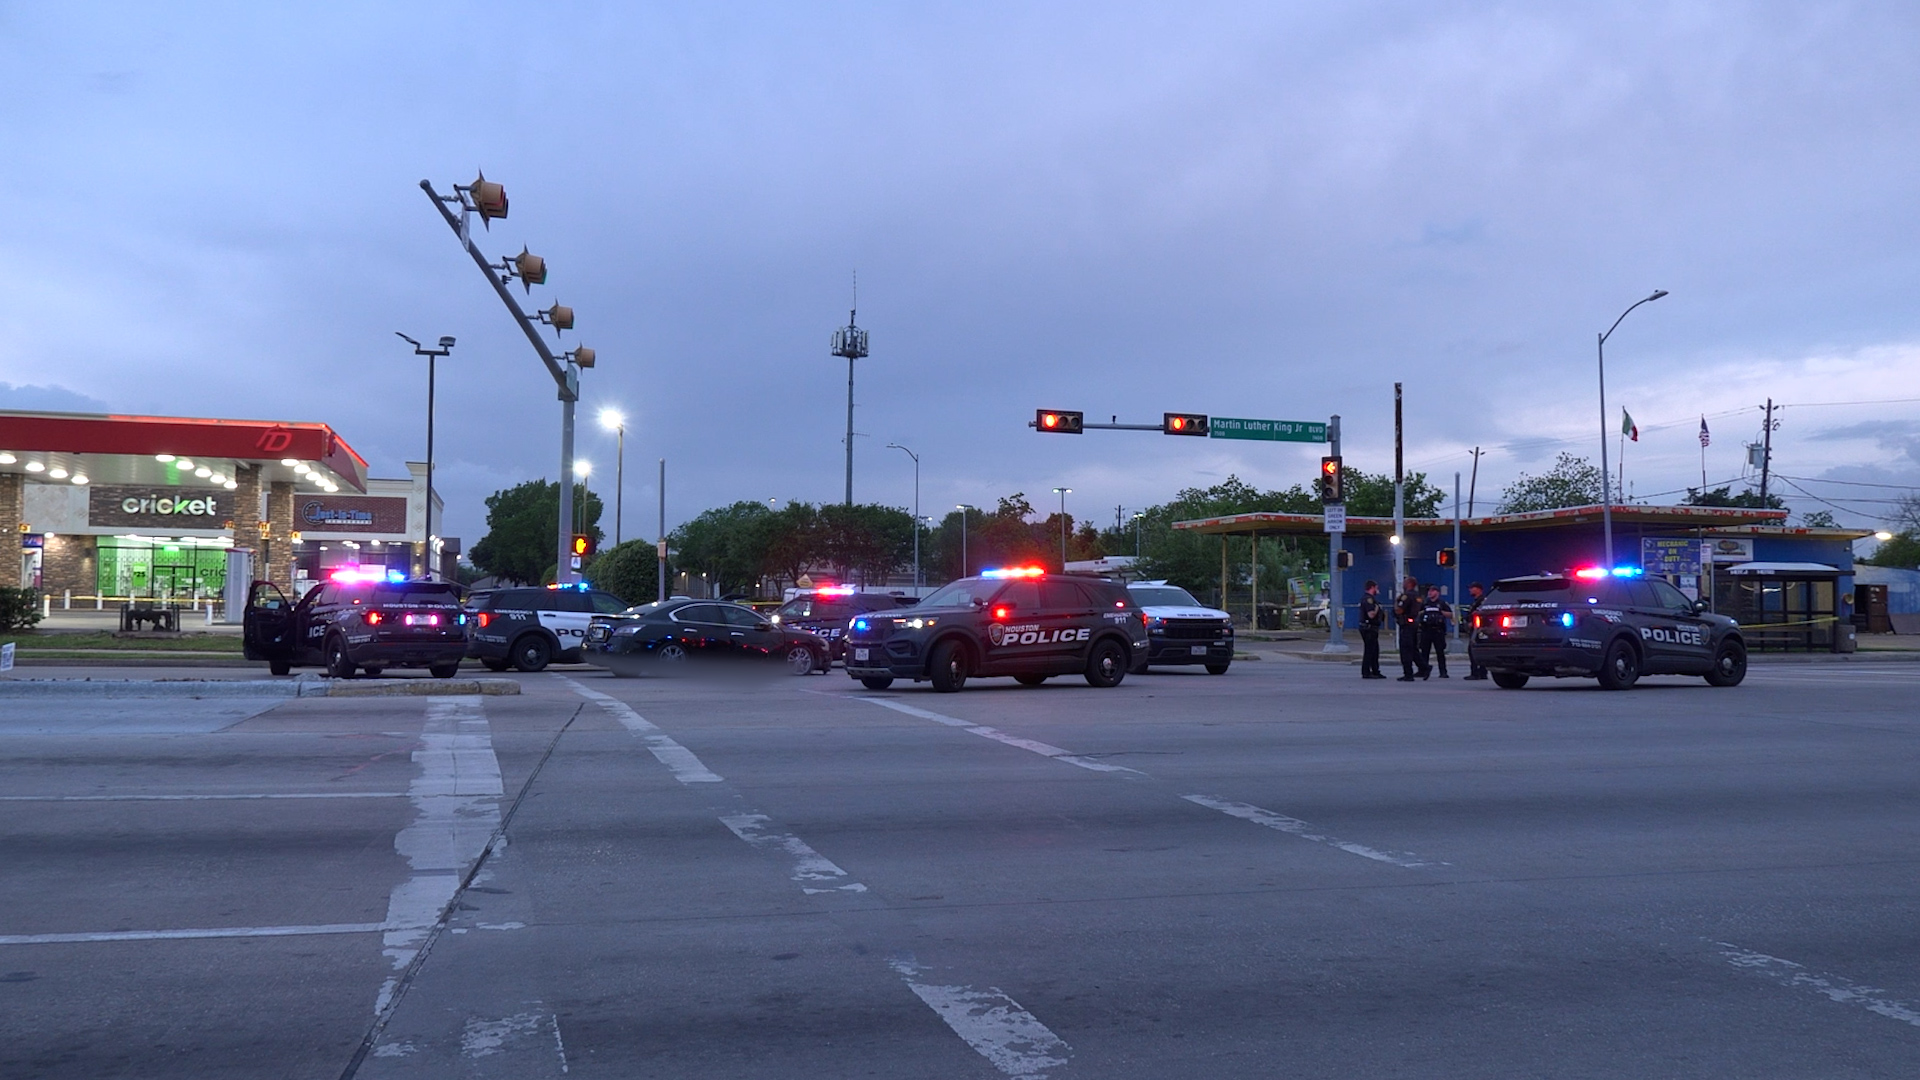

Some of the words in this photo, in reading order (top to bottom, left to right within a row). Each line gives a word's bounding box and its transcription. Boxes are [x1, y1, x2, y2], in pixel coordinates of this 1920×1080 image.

[1213, 419, 1241, 430] Martin
[1243, 421, 1271, 431] Luther
[1273, 422, 1292, 435] King
[1294, 423, 1303, 433] Jr
[122, 494, 217, 516] cricket
[1656, 540, 1688, 548] MECHANIC
[1664, 555, 1681, 563] DUTY
[200, 564, 227, 577] cric
[308, 624, 326, 638] ICE
[1005, 624, 1040, 633] HOUSTON
[1001, 628, 1091, 646] POLICE
[1640, 627, 1703, 645] POLICE
